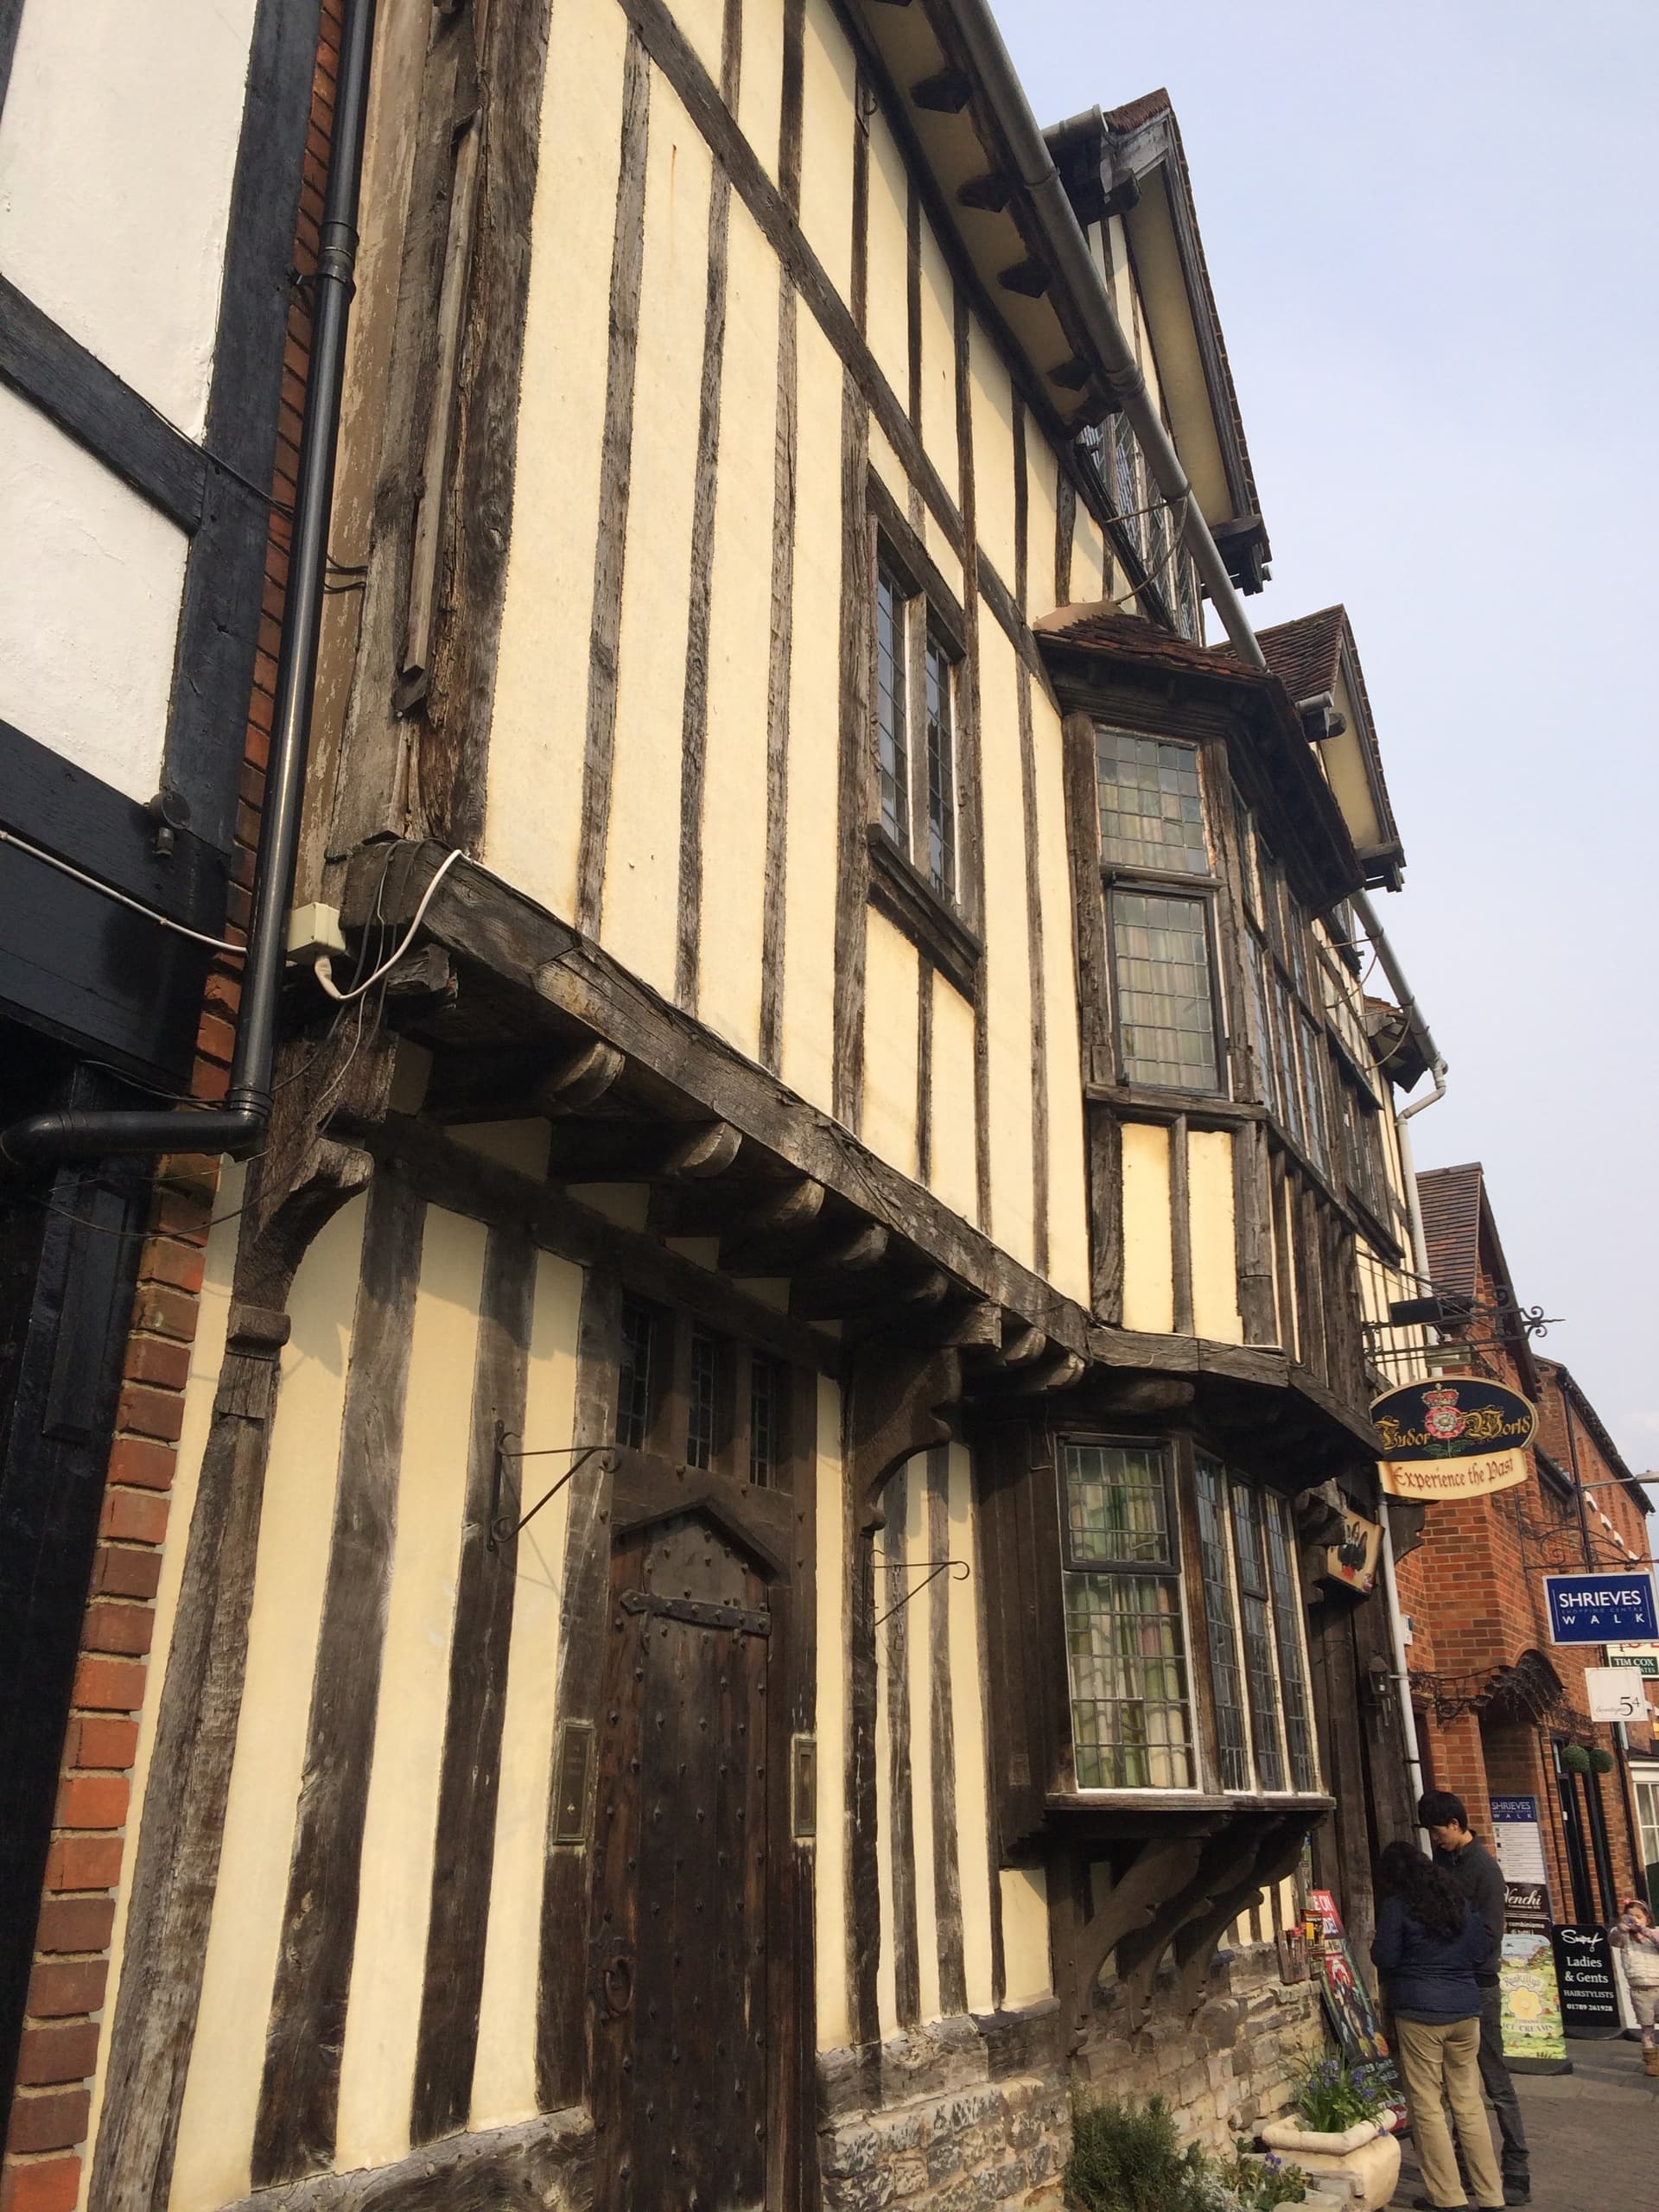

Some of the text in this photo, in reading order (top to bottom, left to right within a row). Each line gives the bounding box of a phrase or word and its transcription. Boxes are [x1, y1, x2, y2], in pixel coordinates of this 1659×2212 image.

[1375, 1405, 1531, 1452] Tudor World
[1394, 1458, 1514, 1491] Experience the Past
[1559, 1590, 1642, 1608] SHRIEVES
[1561, 1612, 1645, 1624] WALK
[1613, 1658, 1655, 1667] TIM COX
[1491, 1802, 1531, 1810] SHRIEVES
[1503, 1885, 1542, 1905] Venchi
[1567, 1956, 1603, 1968] Ladies
[1565, 1971, 1609, 1984] & Gents
[1563, 1990, 1614, 1999] HAIRSTYLISTS
